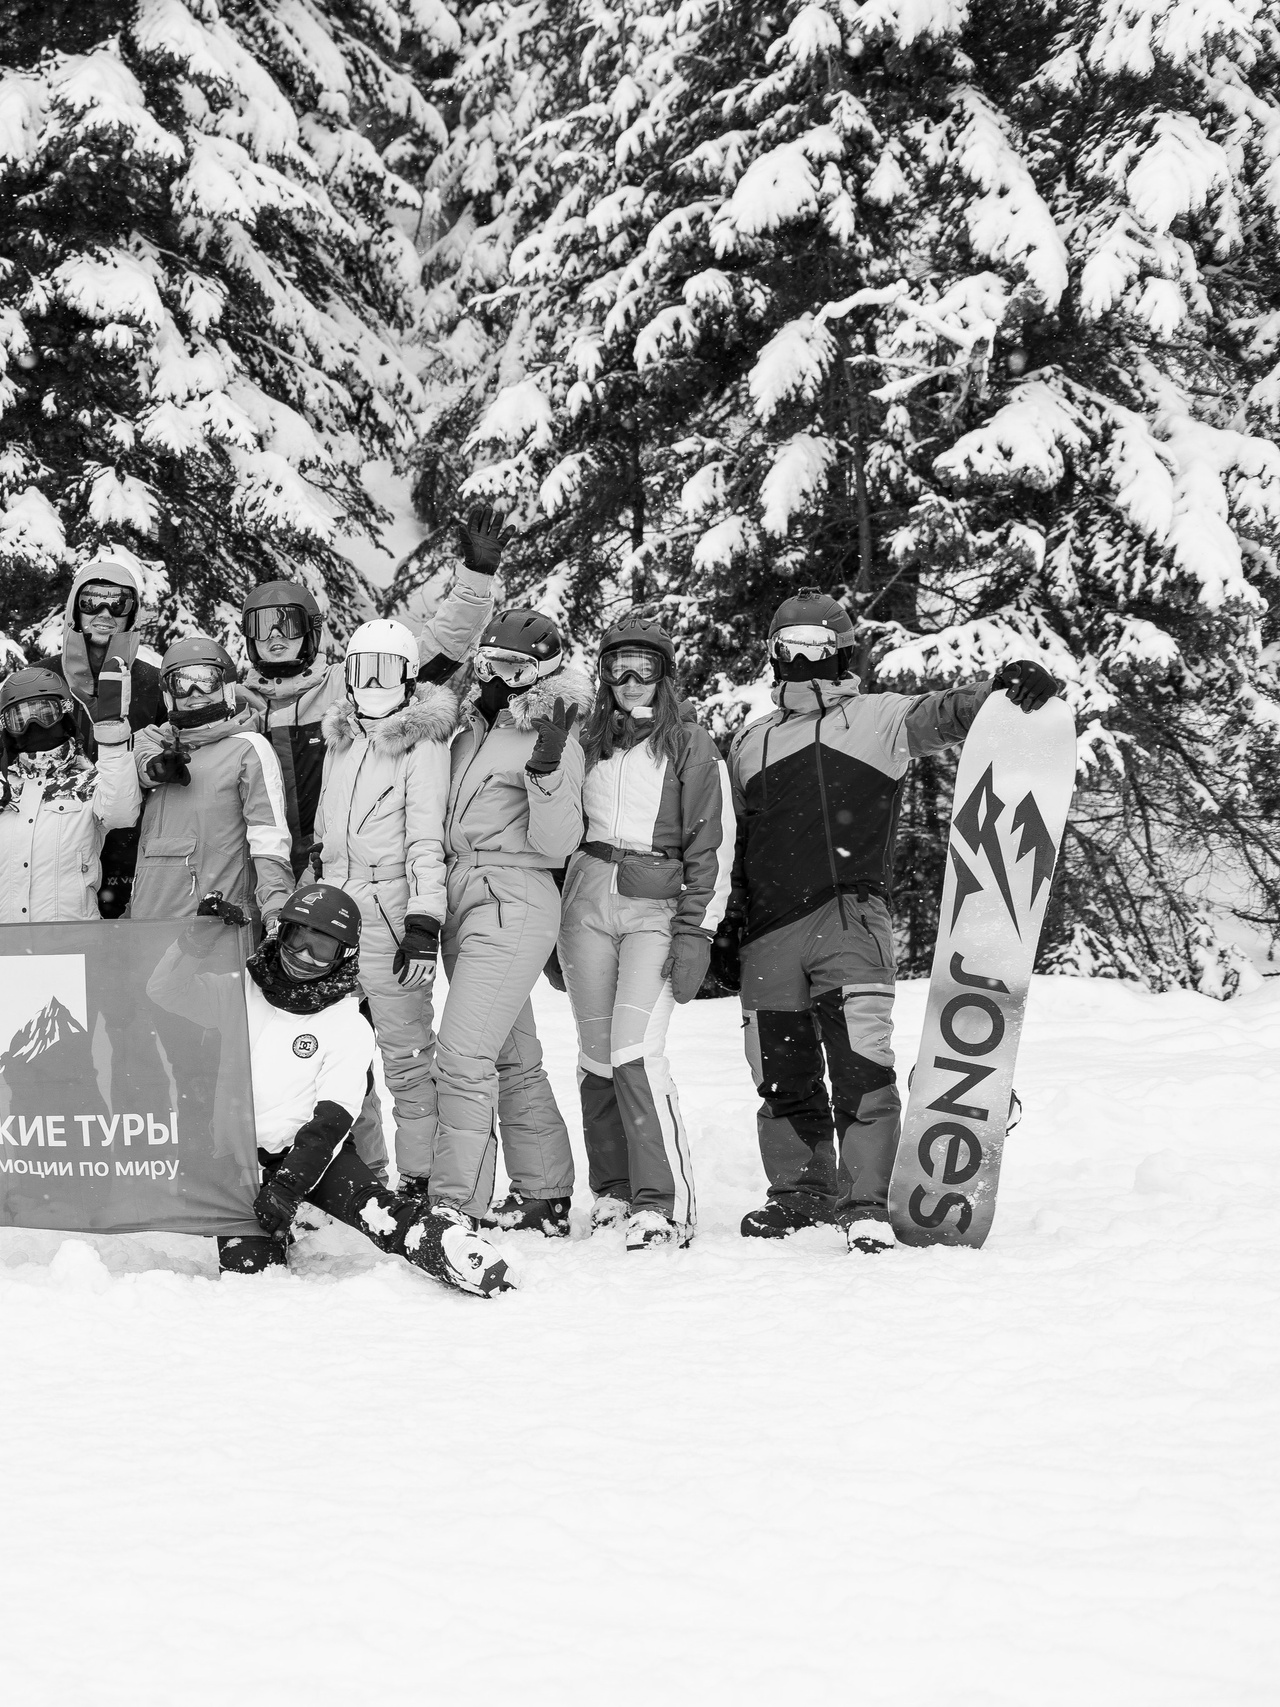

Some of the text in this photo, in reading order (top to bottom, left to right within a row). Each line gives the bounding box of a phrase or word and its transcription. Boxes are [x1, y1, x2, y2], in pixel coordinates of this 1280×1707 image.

[73, 1111, 179, 1147] ТУРЫ
[79, 1159, 110, 1177] по
[115, 1159, 180, 1180] миру
